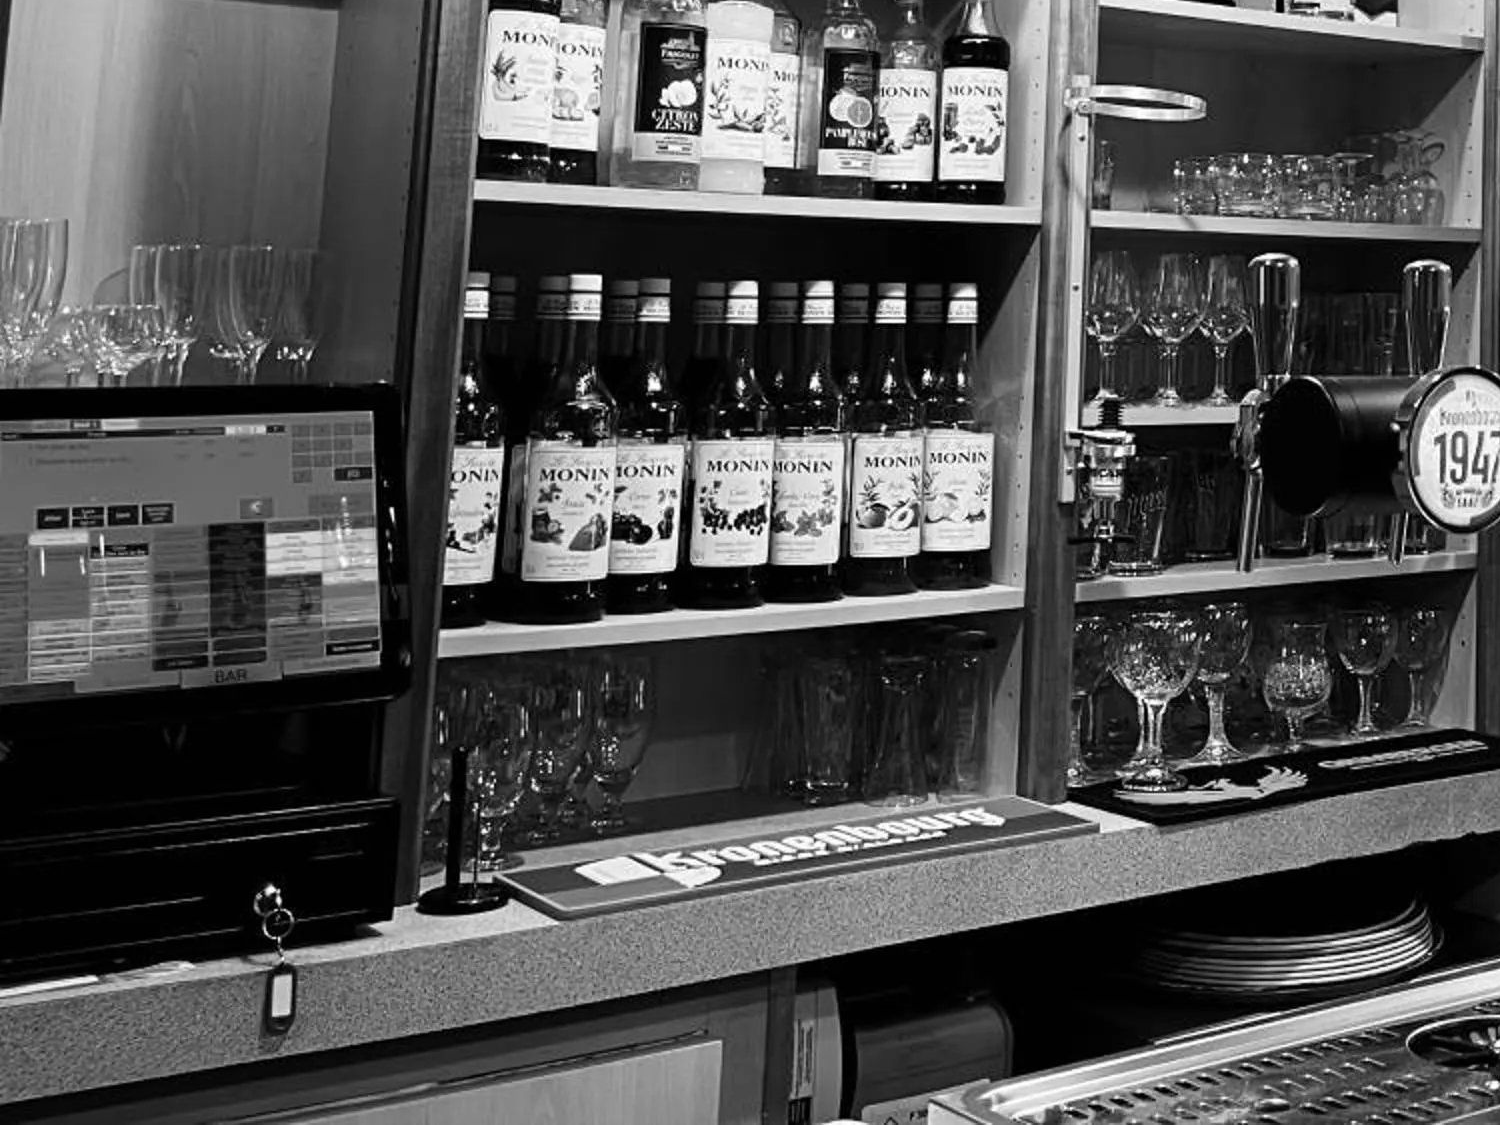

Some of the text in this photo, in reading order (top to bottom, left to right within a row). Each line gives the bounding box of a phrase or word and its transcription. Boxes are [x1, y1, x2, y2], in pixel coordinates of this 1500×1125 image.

[948, 85, 1003, 98] MONIN
[929, 450, 987, 465] MONIN
[706, 459, 769, 474] MONIN
[451, 468, 499, 484] ONIN
[539, 467, 609, 483] MONIN
[214, 669, 248, 684] BAR
